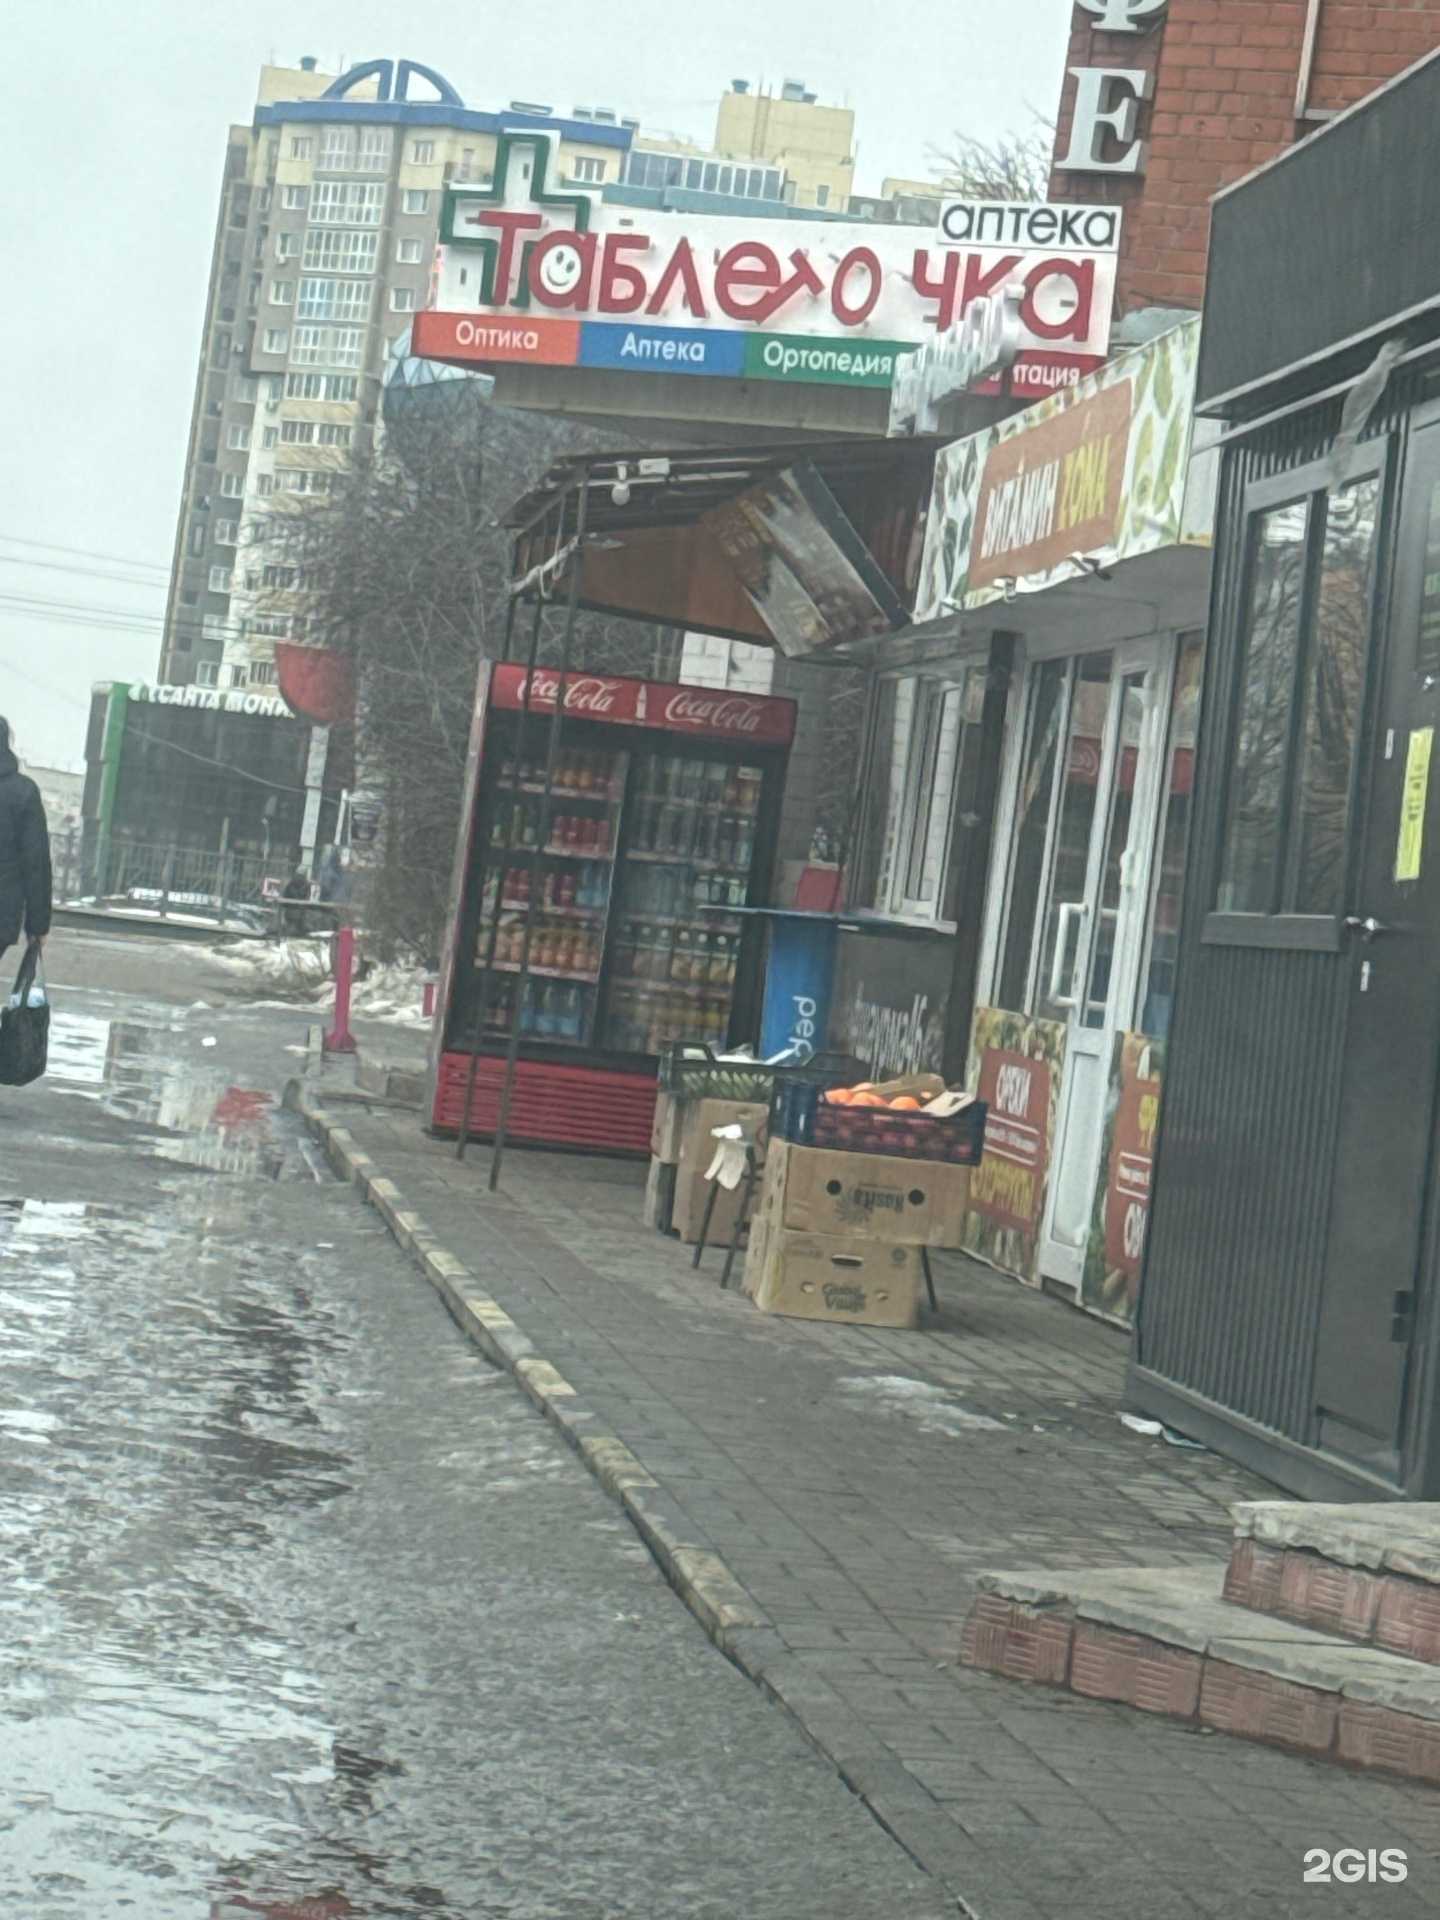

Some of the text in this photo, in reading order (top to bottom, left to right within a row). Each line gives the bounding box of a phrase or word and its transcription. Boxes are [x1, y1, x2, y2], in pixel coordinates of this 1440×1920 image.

[941, 204, 1115, 248] аптека
[455, 319, 539, 351] Оптика
[620, 332, 705, 364] Аптека
[762, 340, 893, 376] Ортопедия
